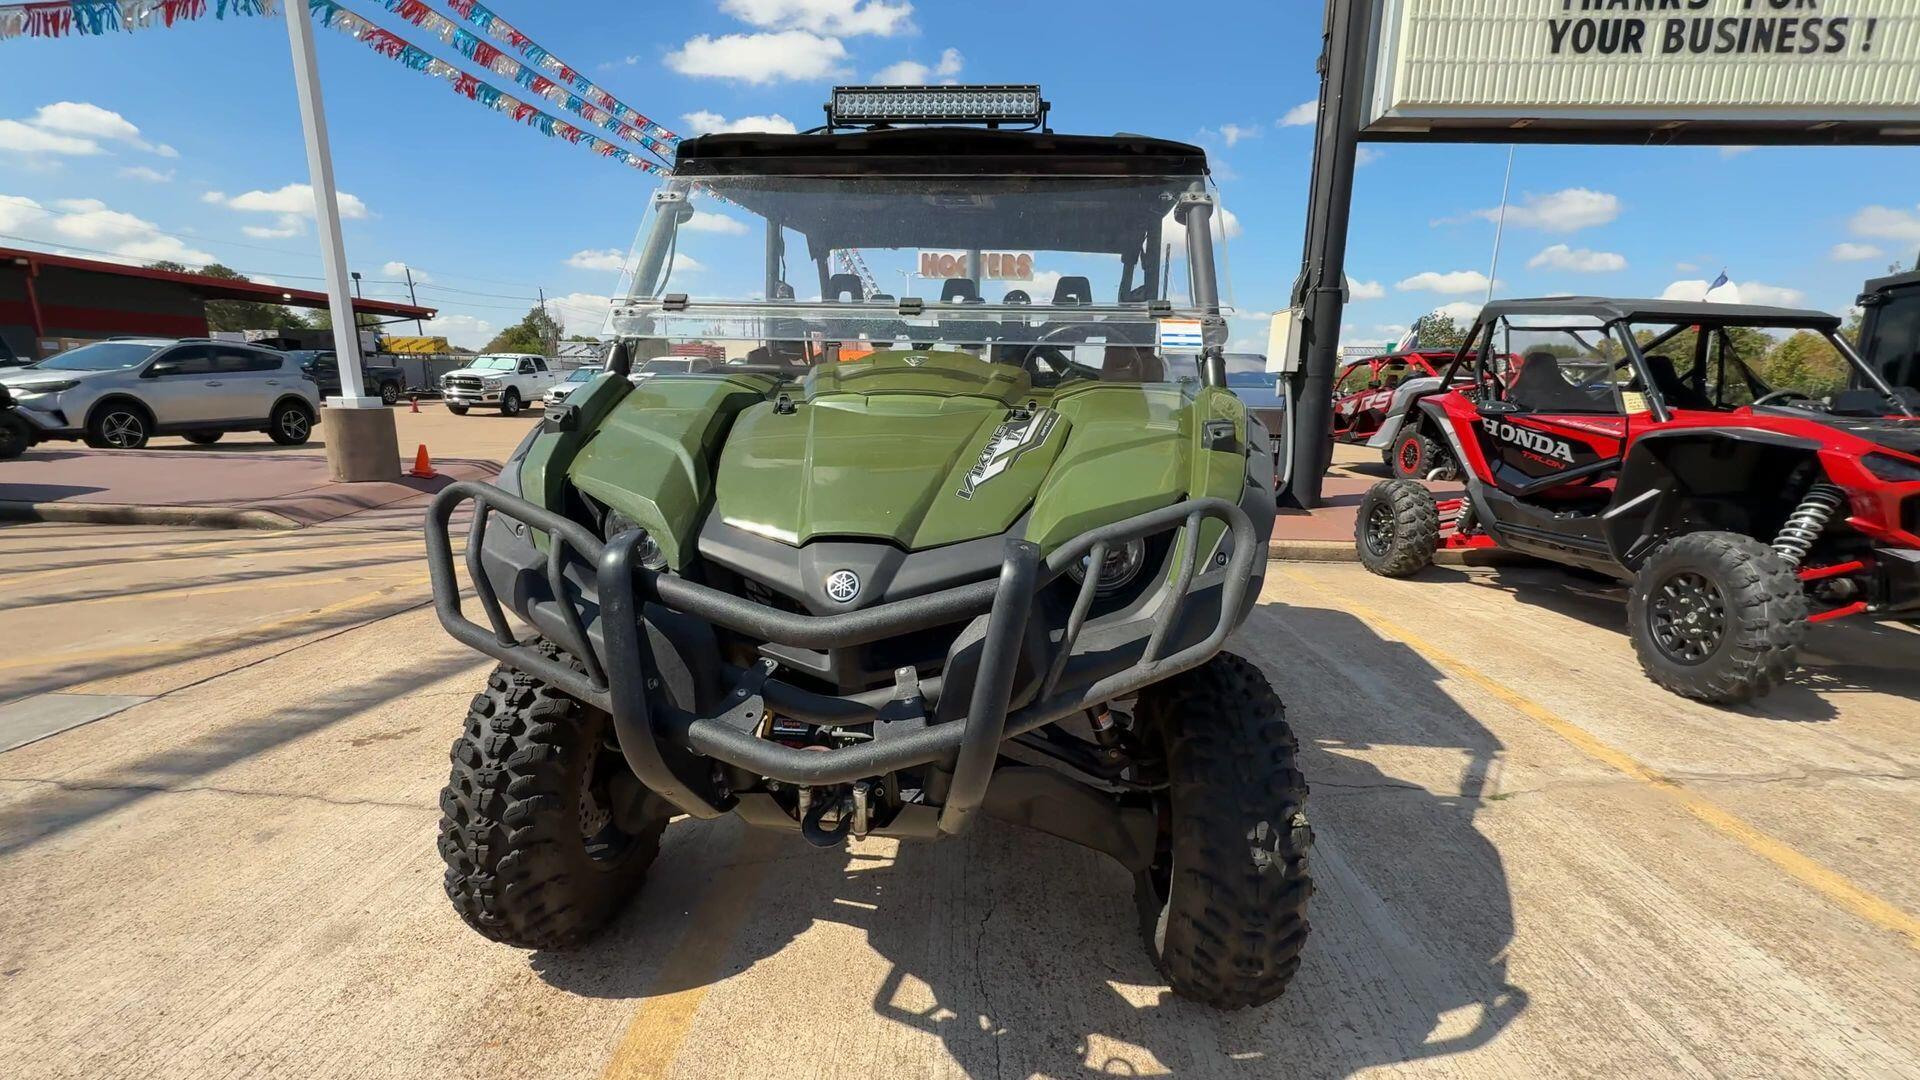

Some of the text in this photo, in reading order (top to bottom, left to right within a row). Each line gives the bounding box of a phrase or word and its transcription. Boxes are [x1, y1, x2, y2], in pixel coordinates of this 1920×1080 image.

[1549, 18, 1645, 54] YOUR
[1662, 17, 1849, 54] BUSINESS
[1482, 416, 1575, 463] HONDA
[1521, 450, 1567, 470] TALON
[956, 425, 1008, 500] VIKING
